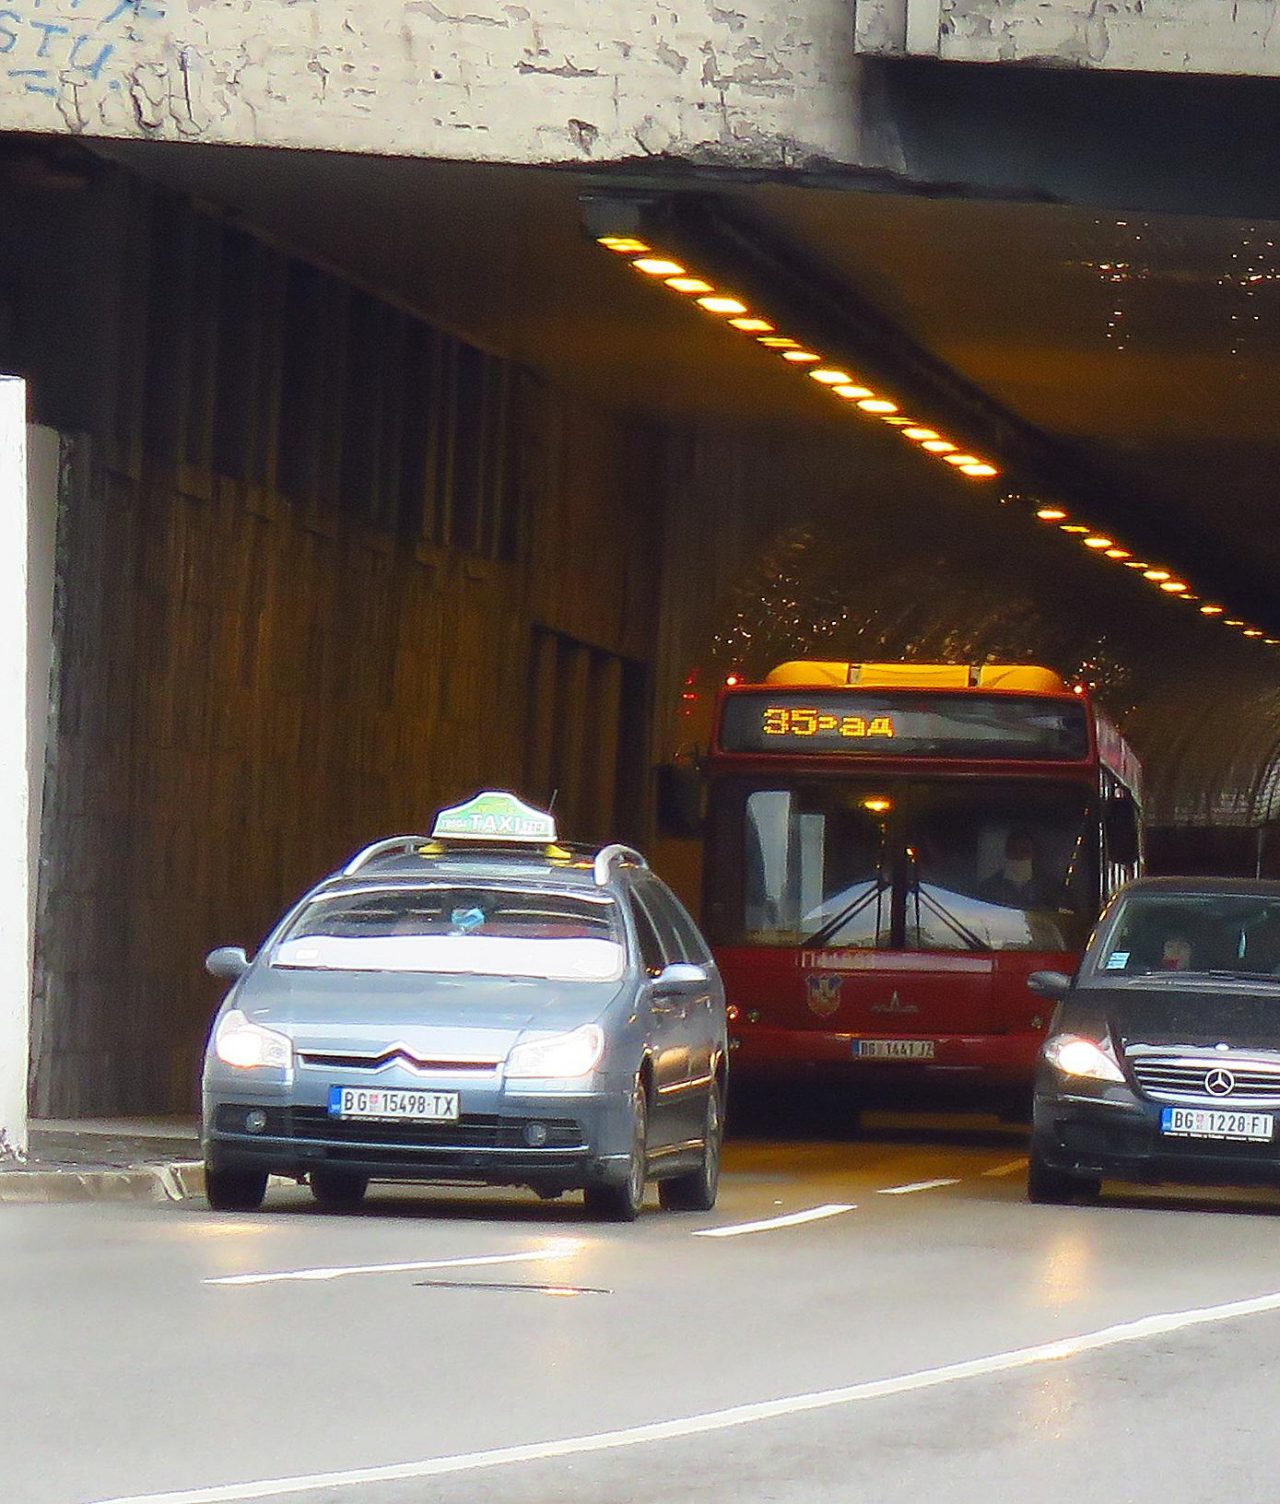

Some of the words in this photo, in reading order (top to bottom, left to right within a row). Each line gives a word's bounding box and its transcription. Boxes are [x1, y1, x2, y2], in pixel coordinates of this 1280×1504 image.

[469, 814, 520, 833] TAXI
[344, 1091, 367, 1111] BG
[1174, 1111, 1194, 1129] BG
